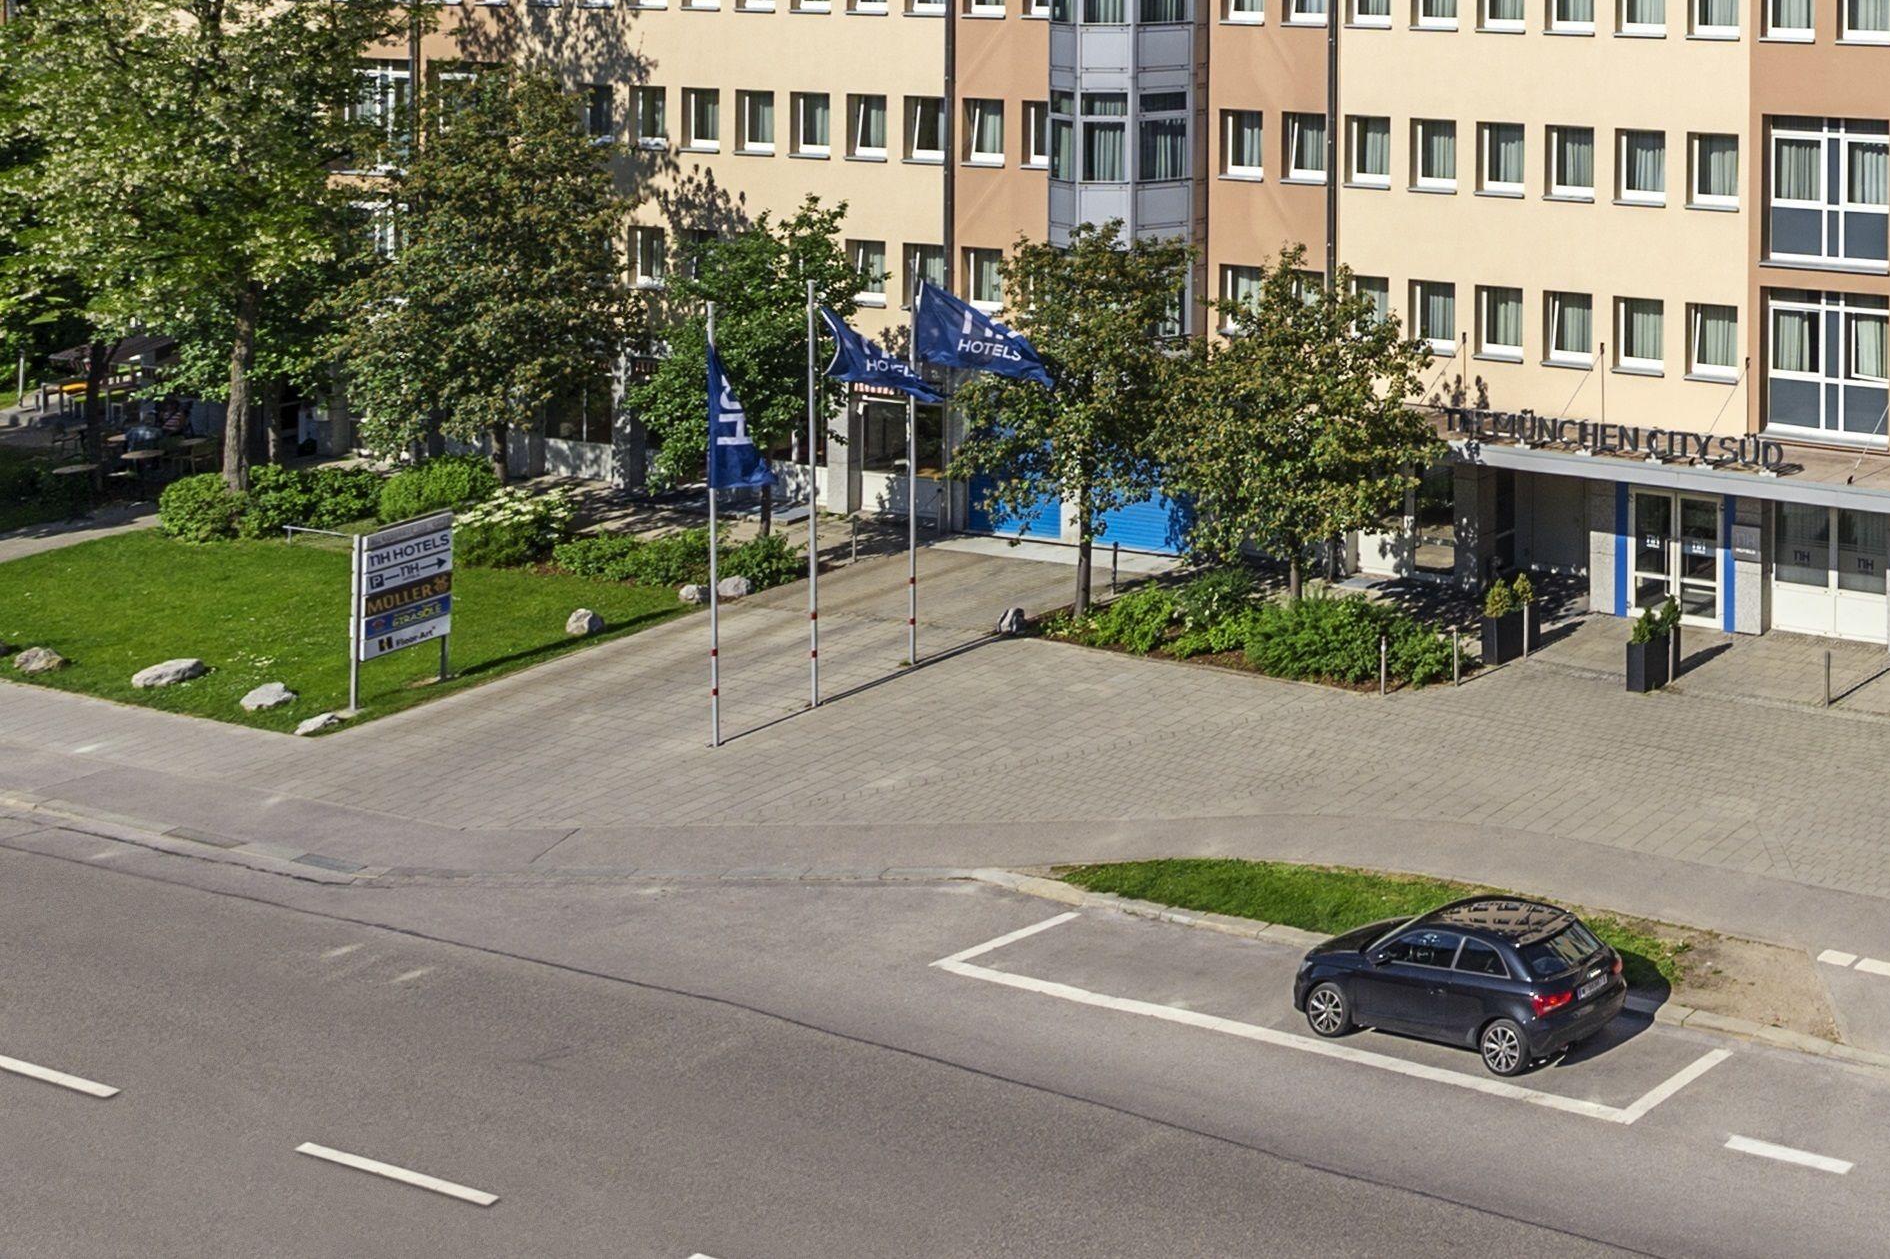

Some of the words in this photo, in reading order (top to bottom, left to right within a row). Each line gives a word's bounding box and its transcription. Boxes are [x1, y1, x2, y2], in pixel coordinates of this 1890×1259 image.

[957, 338, 1022, 361] HOTELS
[1491, 409, 1639, 453] MÜNCHEN
[1646, 429, 1714, 461] CITY
[1719, 433, 1783, 468] SÜD
[393, 534, 450, 560] HOTELS
[371, 575, 383, 589] P
[393, 603, 442, 627] GIRASOLE
